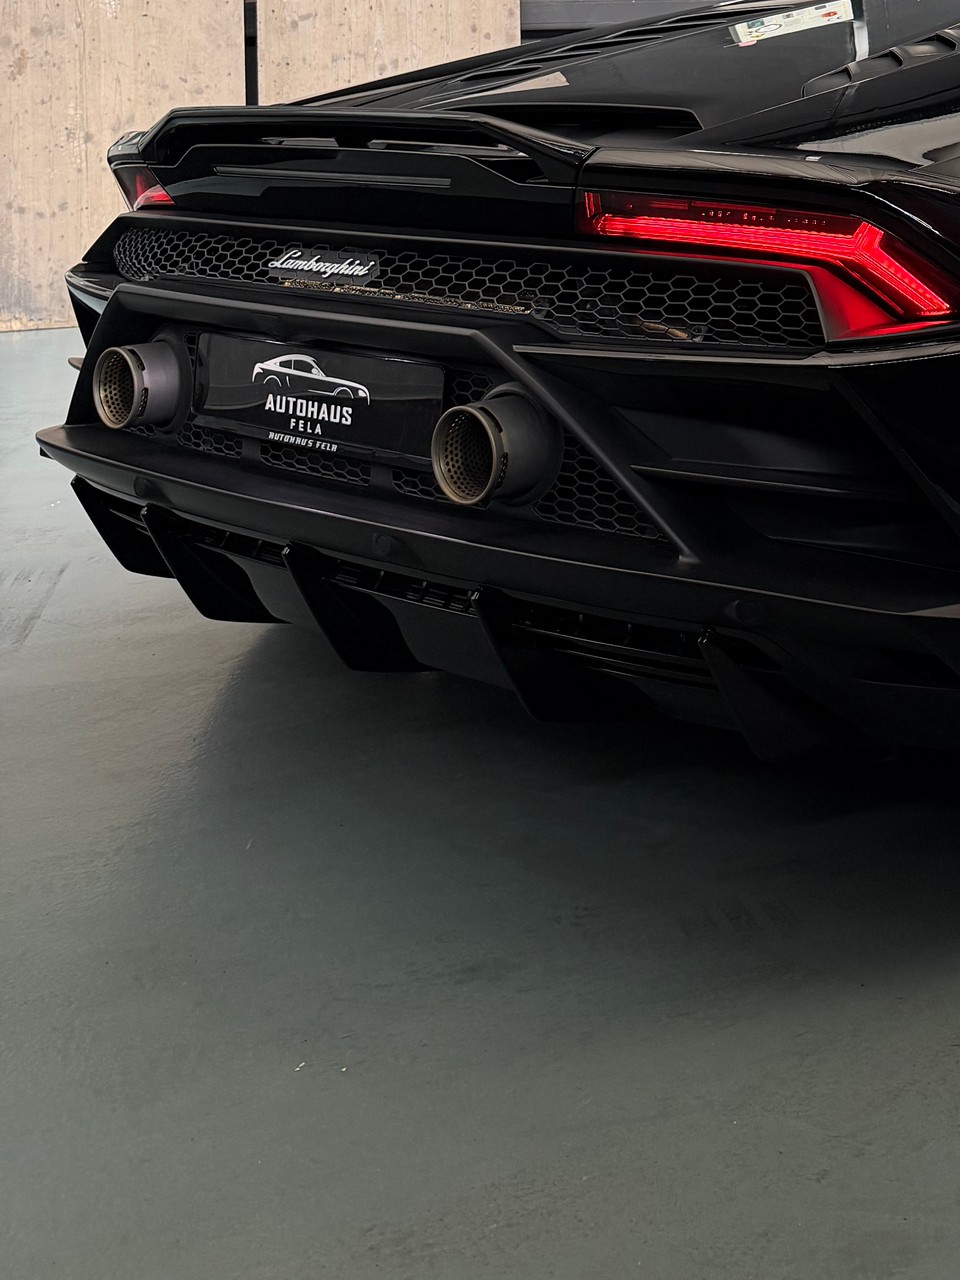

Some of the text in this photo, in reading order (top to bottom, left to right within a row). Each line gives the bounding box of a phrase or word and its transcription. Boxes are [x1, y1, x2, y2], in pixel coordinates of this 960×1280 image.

[268, 249, 375, 277] Lamborghini
[264, 393, 353, 425] AUTOHAUS
[290, 418, 322, 435] FELA
[268, 431, 338, 452] AUTOHAUS FELA
